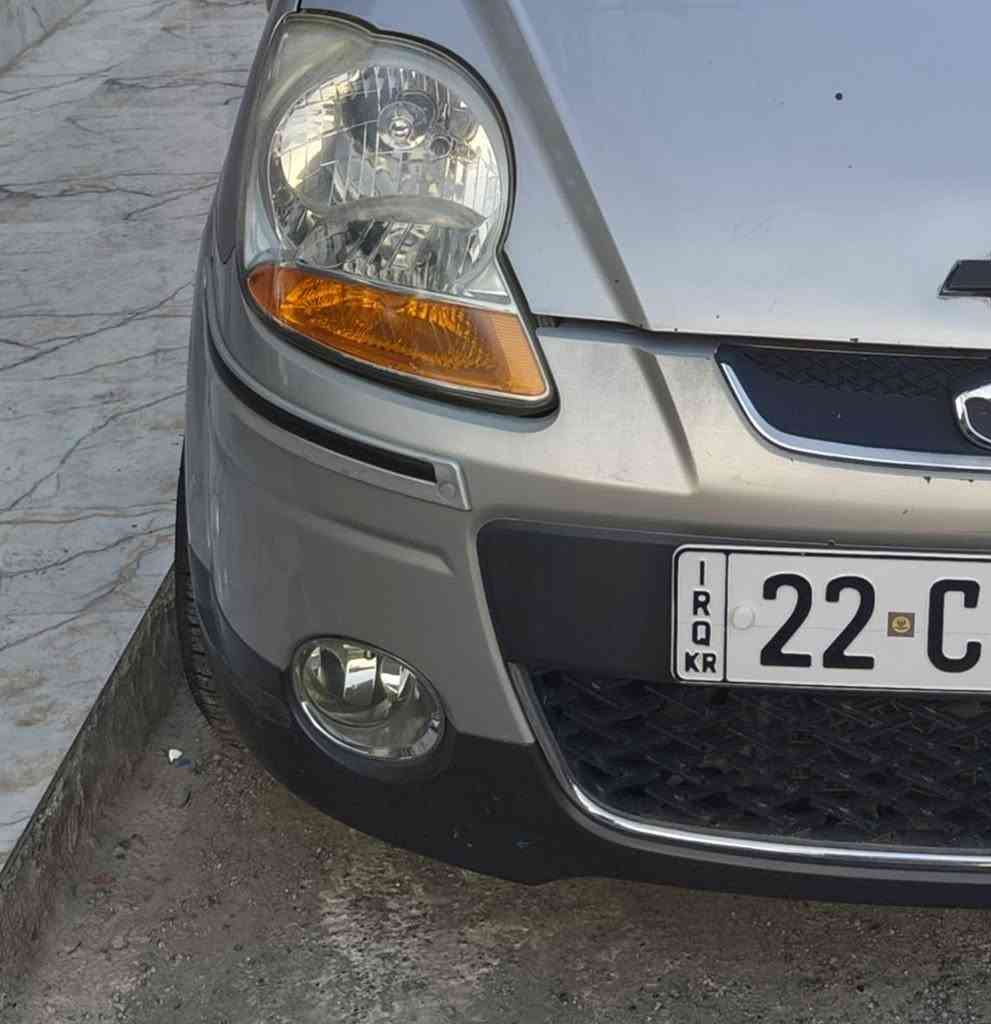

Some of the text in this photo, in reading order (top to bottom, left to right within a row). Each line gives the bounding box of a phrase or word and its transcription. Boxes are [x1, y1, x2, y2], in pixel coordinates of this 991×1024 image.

[760, 573, 876, 671] 22
[926, 578, 983, 674] C
[684, 651, 718, 674] KR
